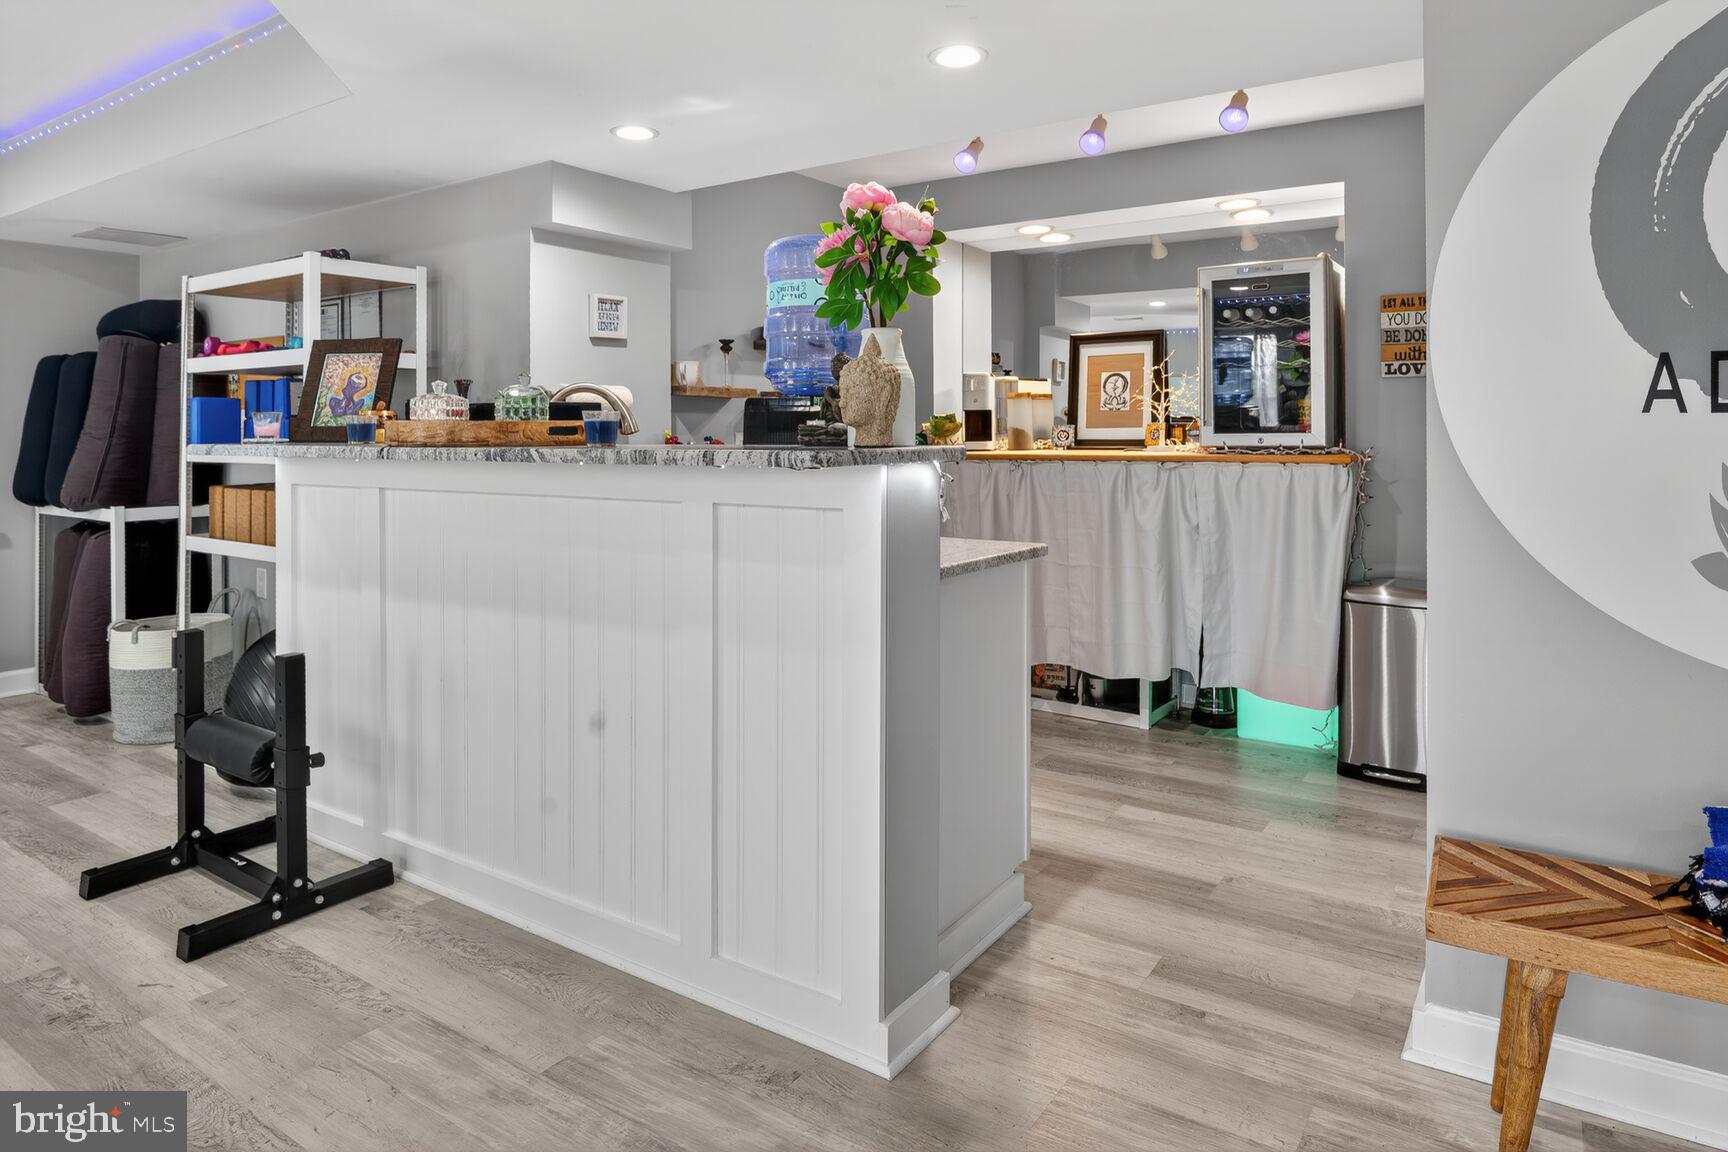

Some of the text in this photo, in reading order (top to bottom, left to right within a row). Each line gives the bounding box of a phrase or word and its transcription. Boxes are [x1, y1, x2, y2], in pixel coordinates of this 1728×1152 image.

[1383, 298, 1396, 309] LET
[1399, 296, 1415, 307] ALL
[1387, 312, 1410, 326] YOU
[1384, 329, 1400, 342] BE
[1394, 345, 1426, 361] with
[1384, 362, 1426, 376] LOV
